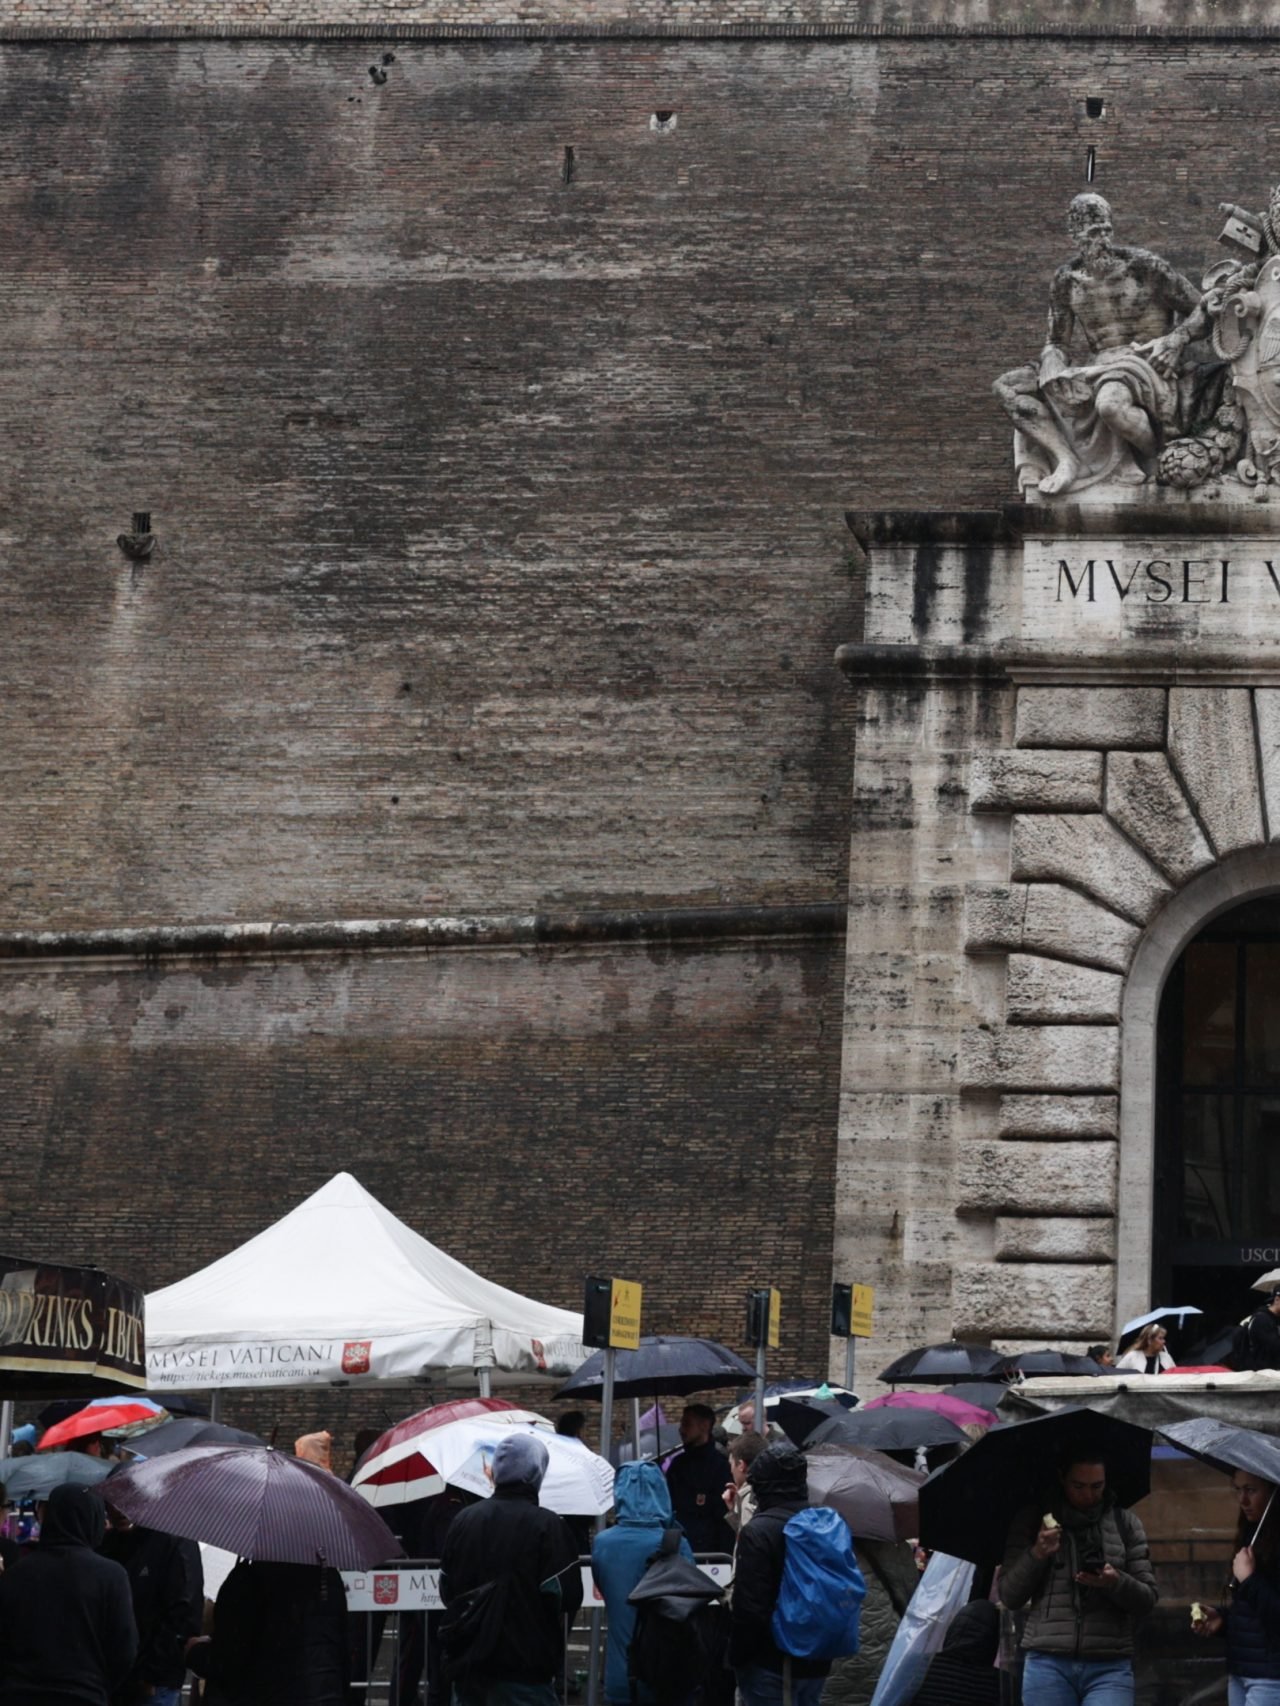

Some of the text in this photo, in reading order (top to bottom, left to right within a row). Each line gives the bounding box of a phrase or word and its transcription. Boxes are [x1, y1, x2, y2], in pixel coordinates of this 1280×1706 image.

[1055, 559, 1233, 603] MVSEI
[11, 1291, 94, 1351] DRINKS
[99, 1306, 143, 1366] IBIT
[148, 1344, 334, 1369] MVSEI VATICANI
